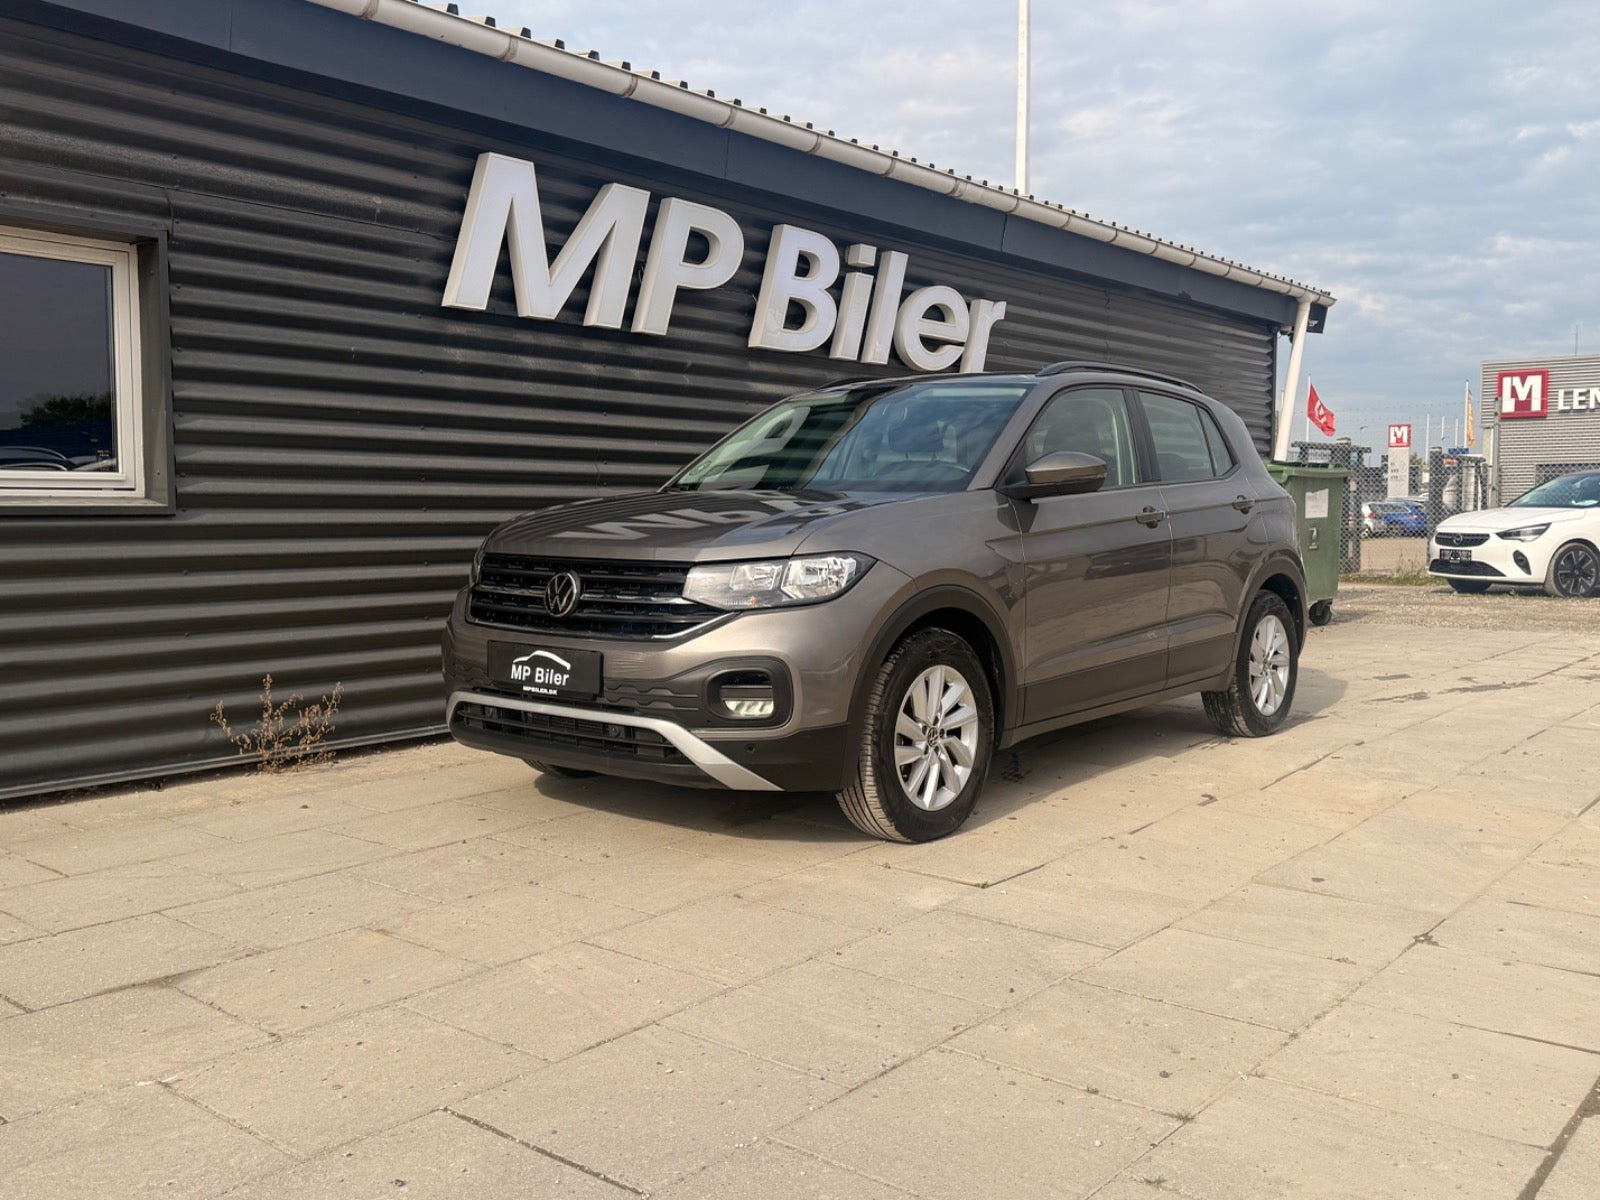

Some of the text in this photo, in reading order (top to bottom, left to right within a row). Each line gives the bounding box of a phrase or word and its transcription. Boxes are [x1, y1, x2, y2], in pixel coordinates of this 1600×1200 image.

[442, 151, 1006, 374] MP Biler
[510, 664, 570, 686] MP Biler
